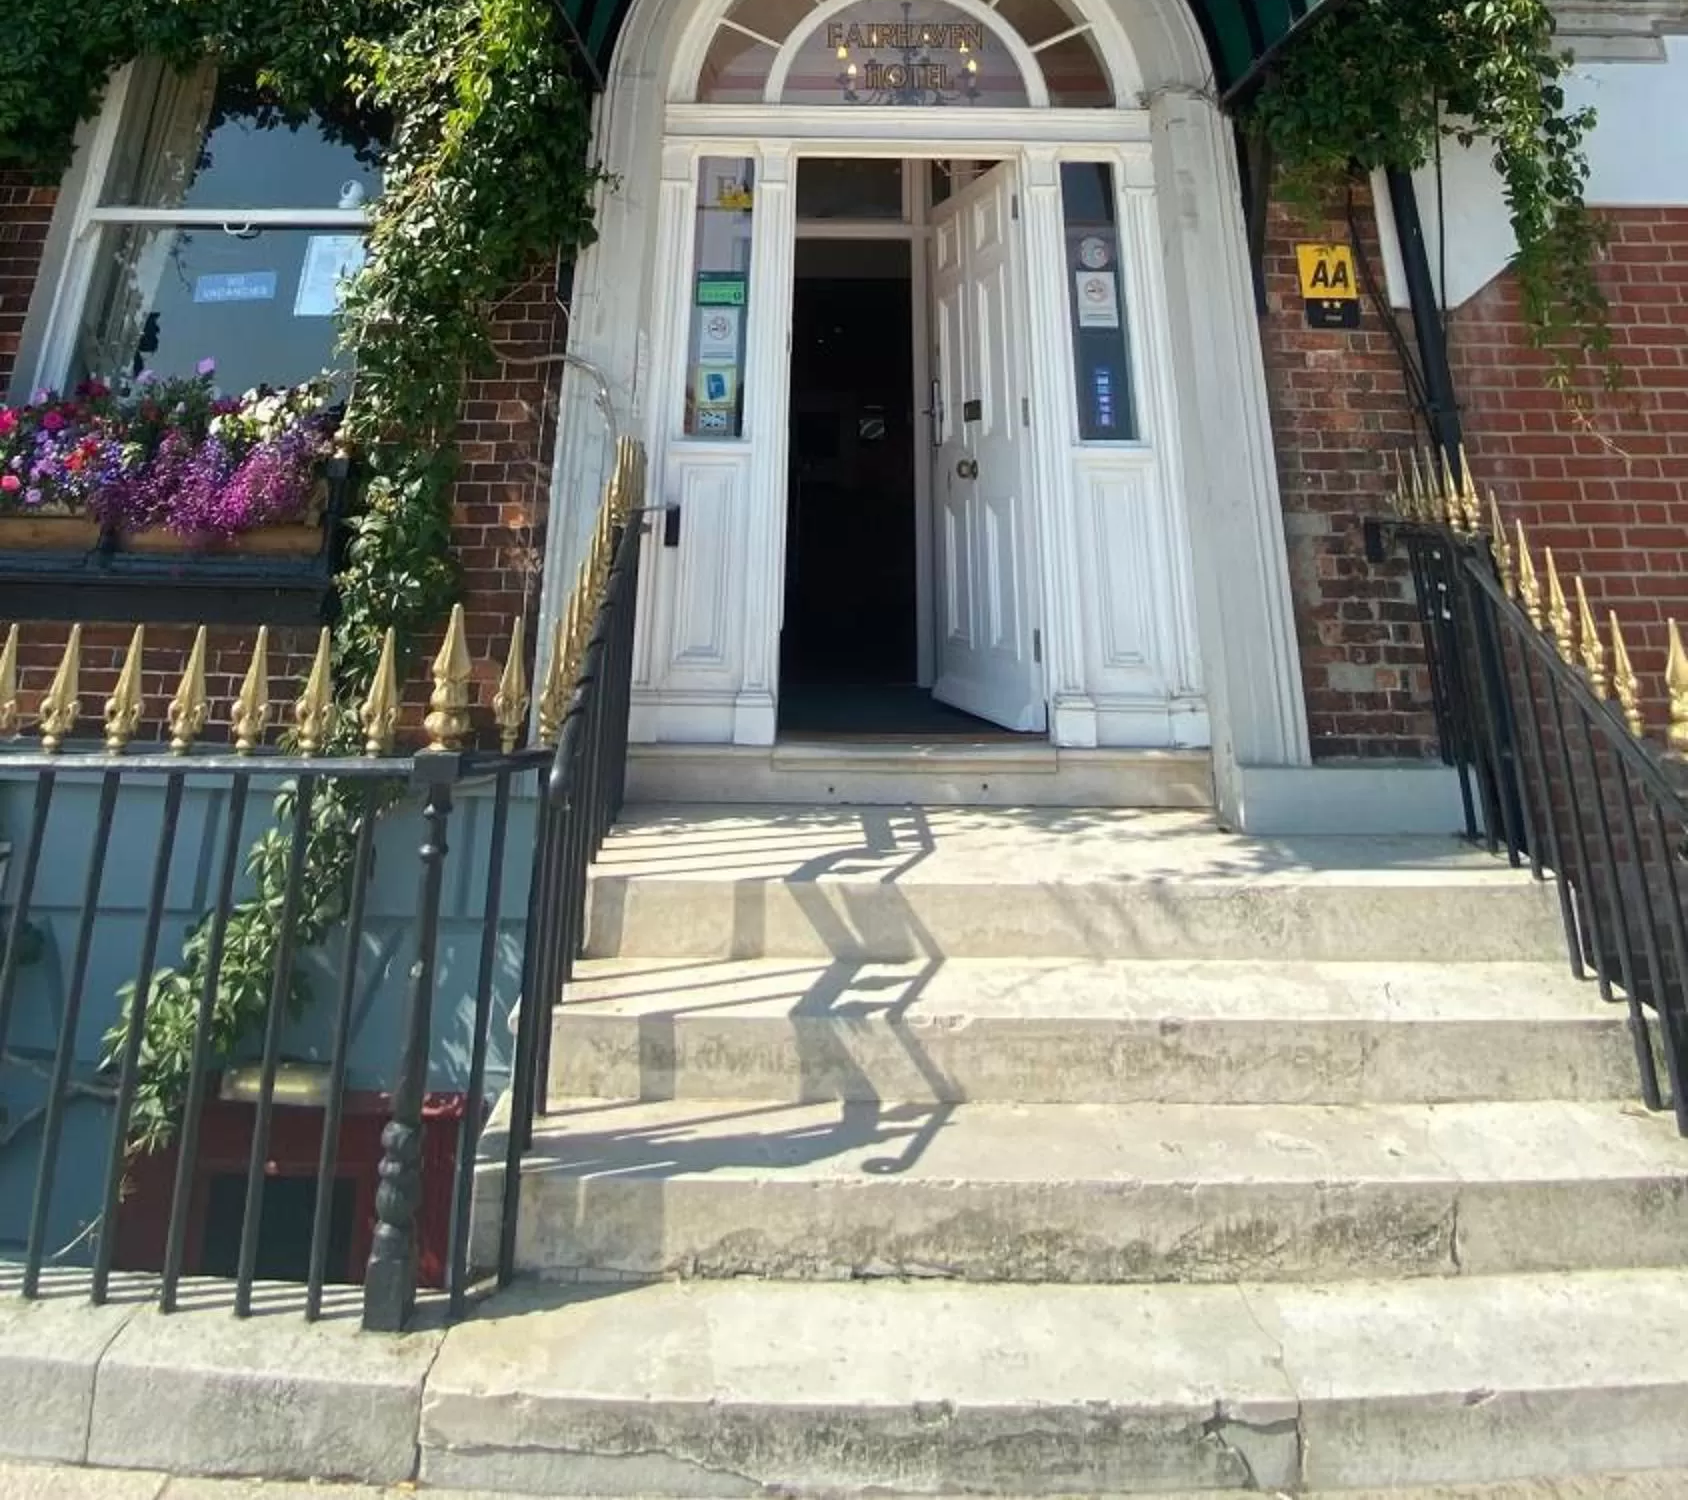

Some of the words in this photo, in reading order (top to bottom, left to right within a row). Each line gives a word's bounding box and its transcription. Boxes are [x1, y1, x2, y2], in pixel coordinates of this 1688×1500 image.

[827, 22, 984, 50] FAIRHAVEN
[863, 62, 955, 90] HOTEL
[1309, 259, 1349, 289] AA
